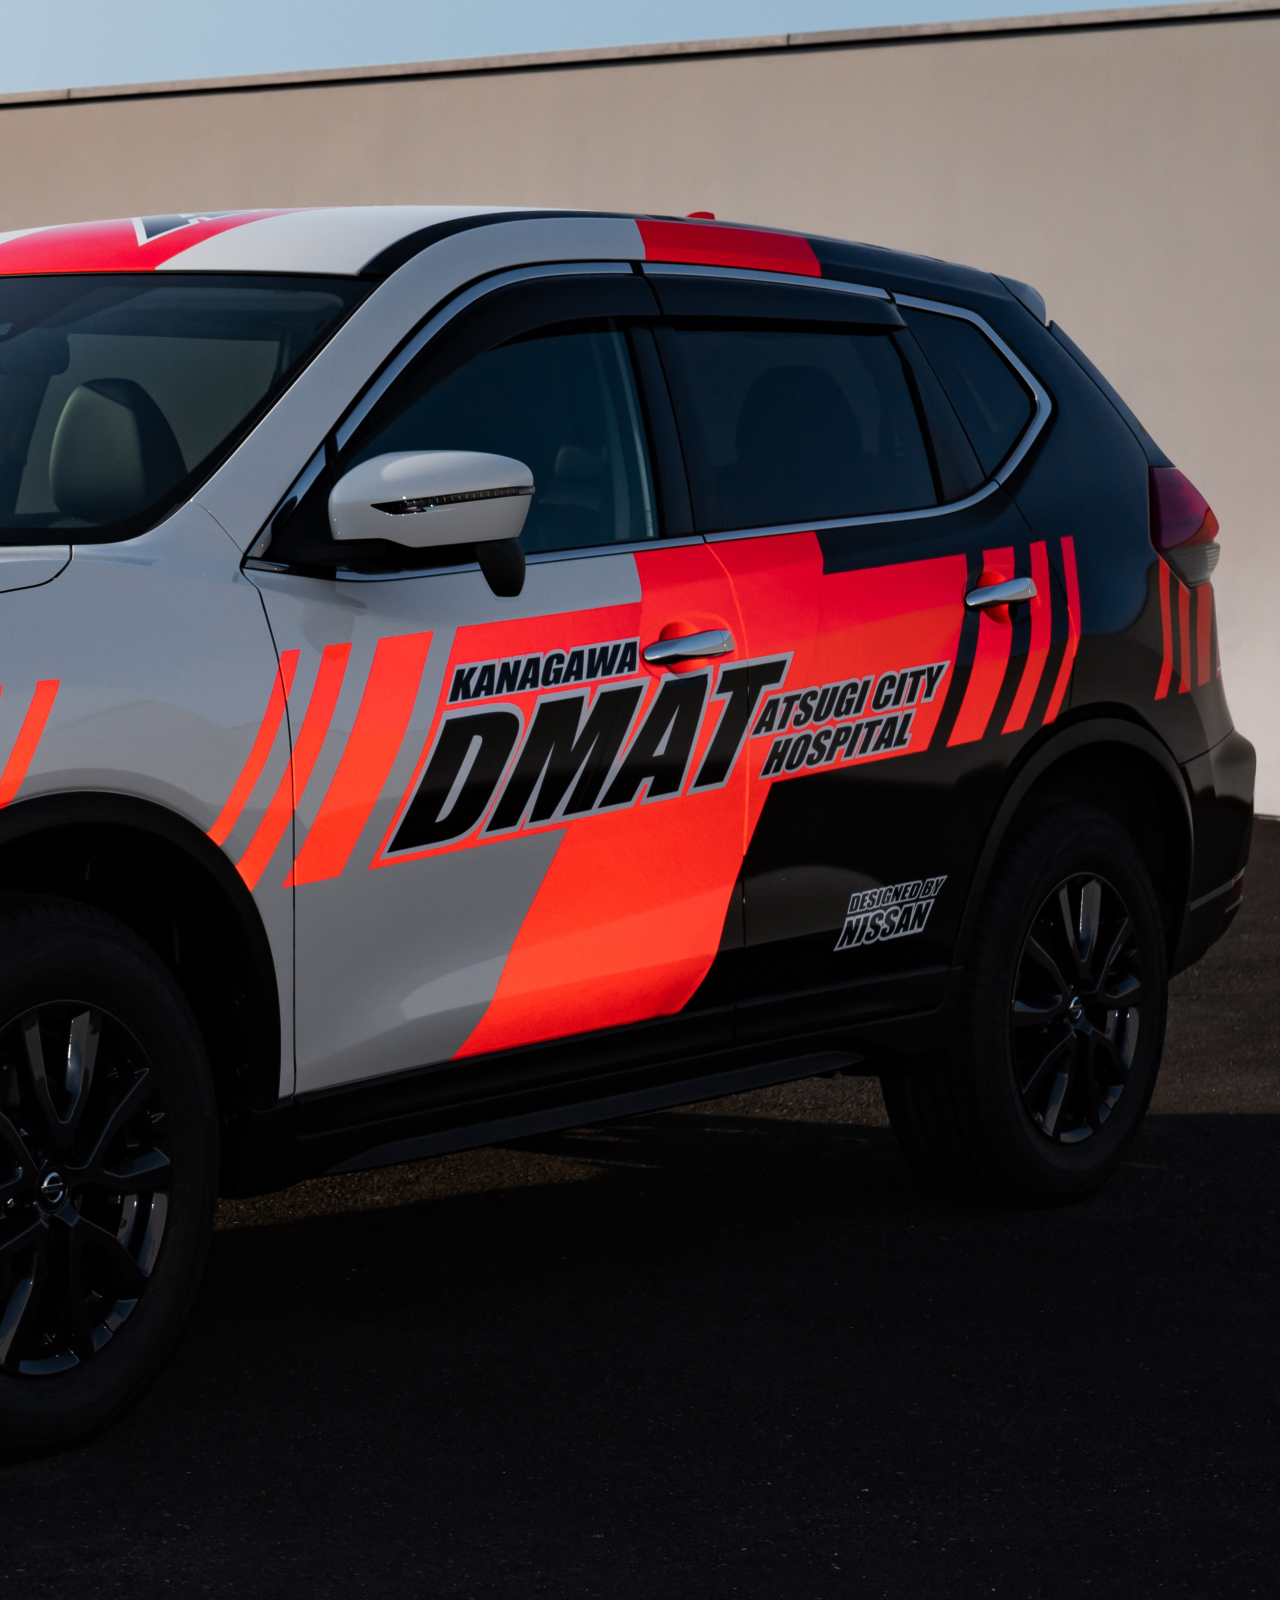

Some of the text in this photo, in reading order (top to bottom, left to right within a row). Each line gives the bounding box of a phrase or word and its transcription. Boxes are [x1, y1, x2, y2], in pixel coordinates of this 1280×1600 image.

[448, 638, 639, 703] KANAGAWA
[752, 663, 948, 736] ATSUGI CITY
[380, 652, 793, 859] DMAT
[760, 709, 916, 779] HOSPITAL
[834, 898, 935, 951] NISSAN
[847, 875, 948, 914] DESIGNED BY
